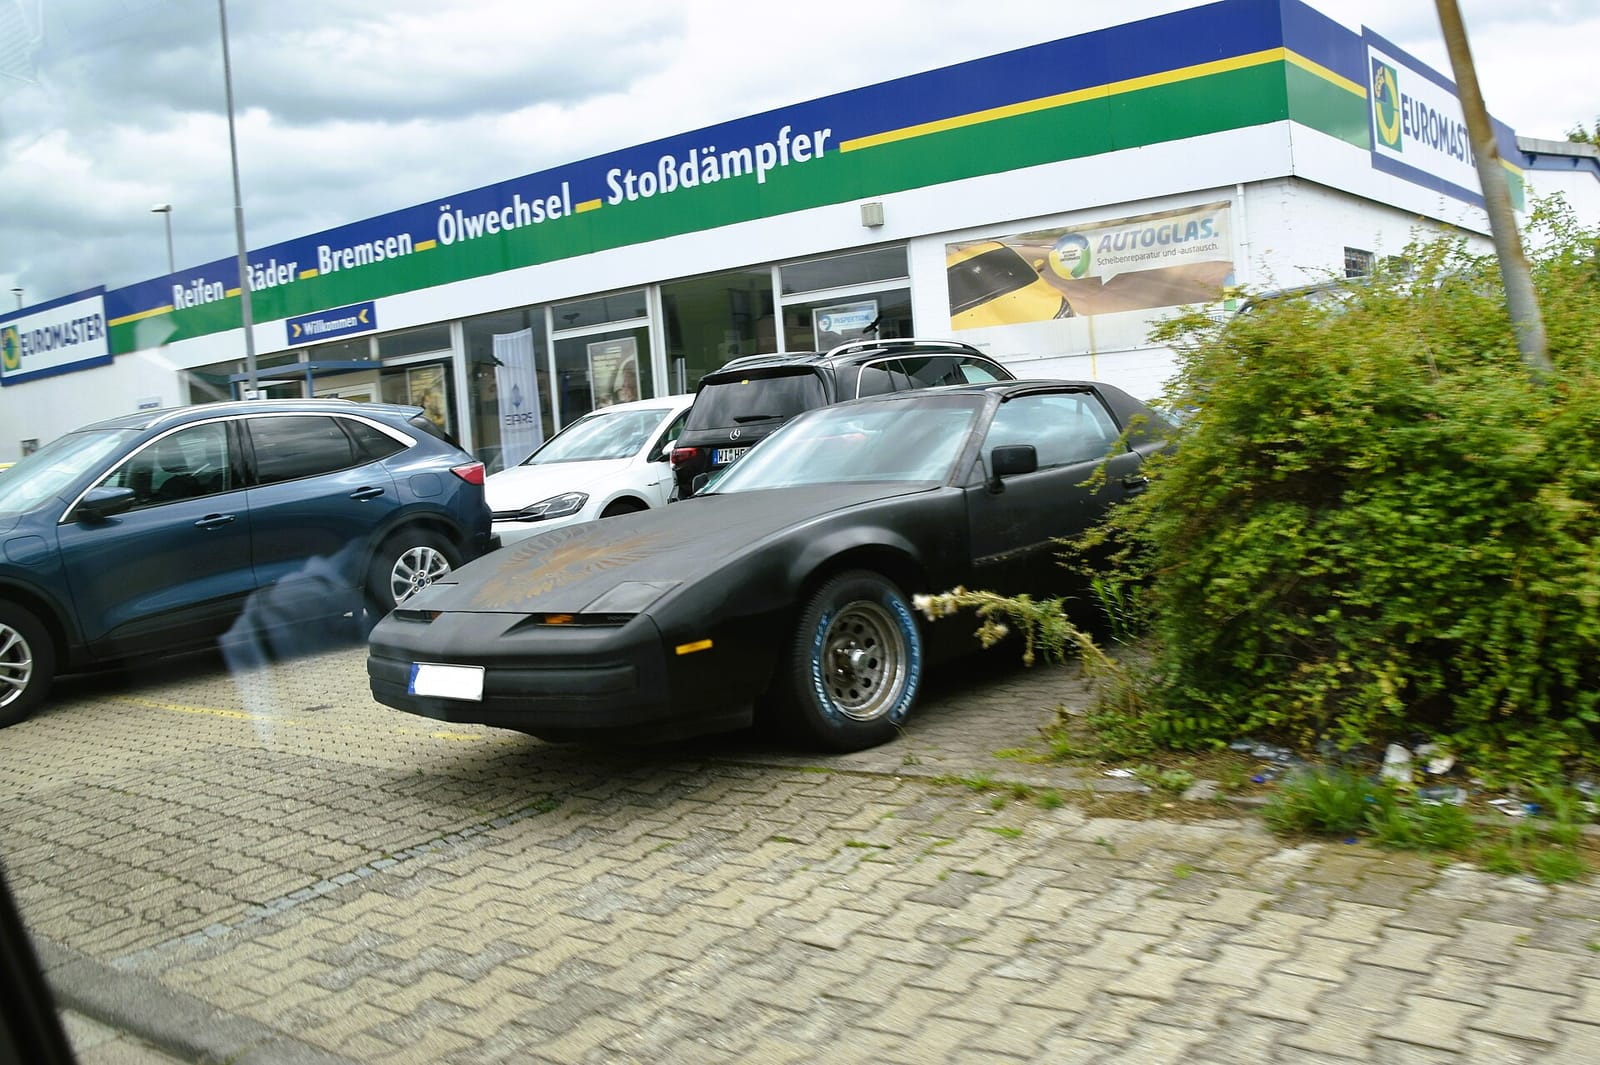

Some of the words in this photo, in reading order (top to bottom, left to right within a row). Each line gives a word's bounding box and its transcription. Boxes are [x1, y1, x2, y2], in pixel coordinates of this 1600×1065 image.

[1401, 92, 1476, 168] EUROMAST
[172, 278, 224, 310] Reifen
[317, 233, 412, 275] Bremsen
[437, 181, 572, 246] Ölwechsel
[606, 125, 832, 206] Stoßdämpfer
[1097, 218, 1219, 254] AUTOGLAS.
[1097, 249, 1161, 266] Scheibenreparatur
[1162, 248, 1177, 258] und
[20, 313, 104, 356] EUROMASTER
[302, 316, 358, 336] Willkommen
